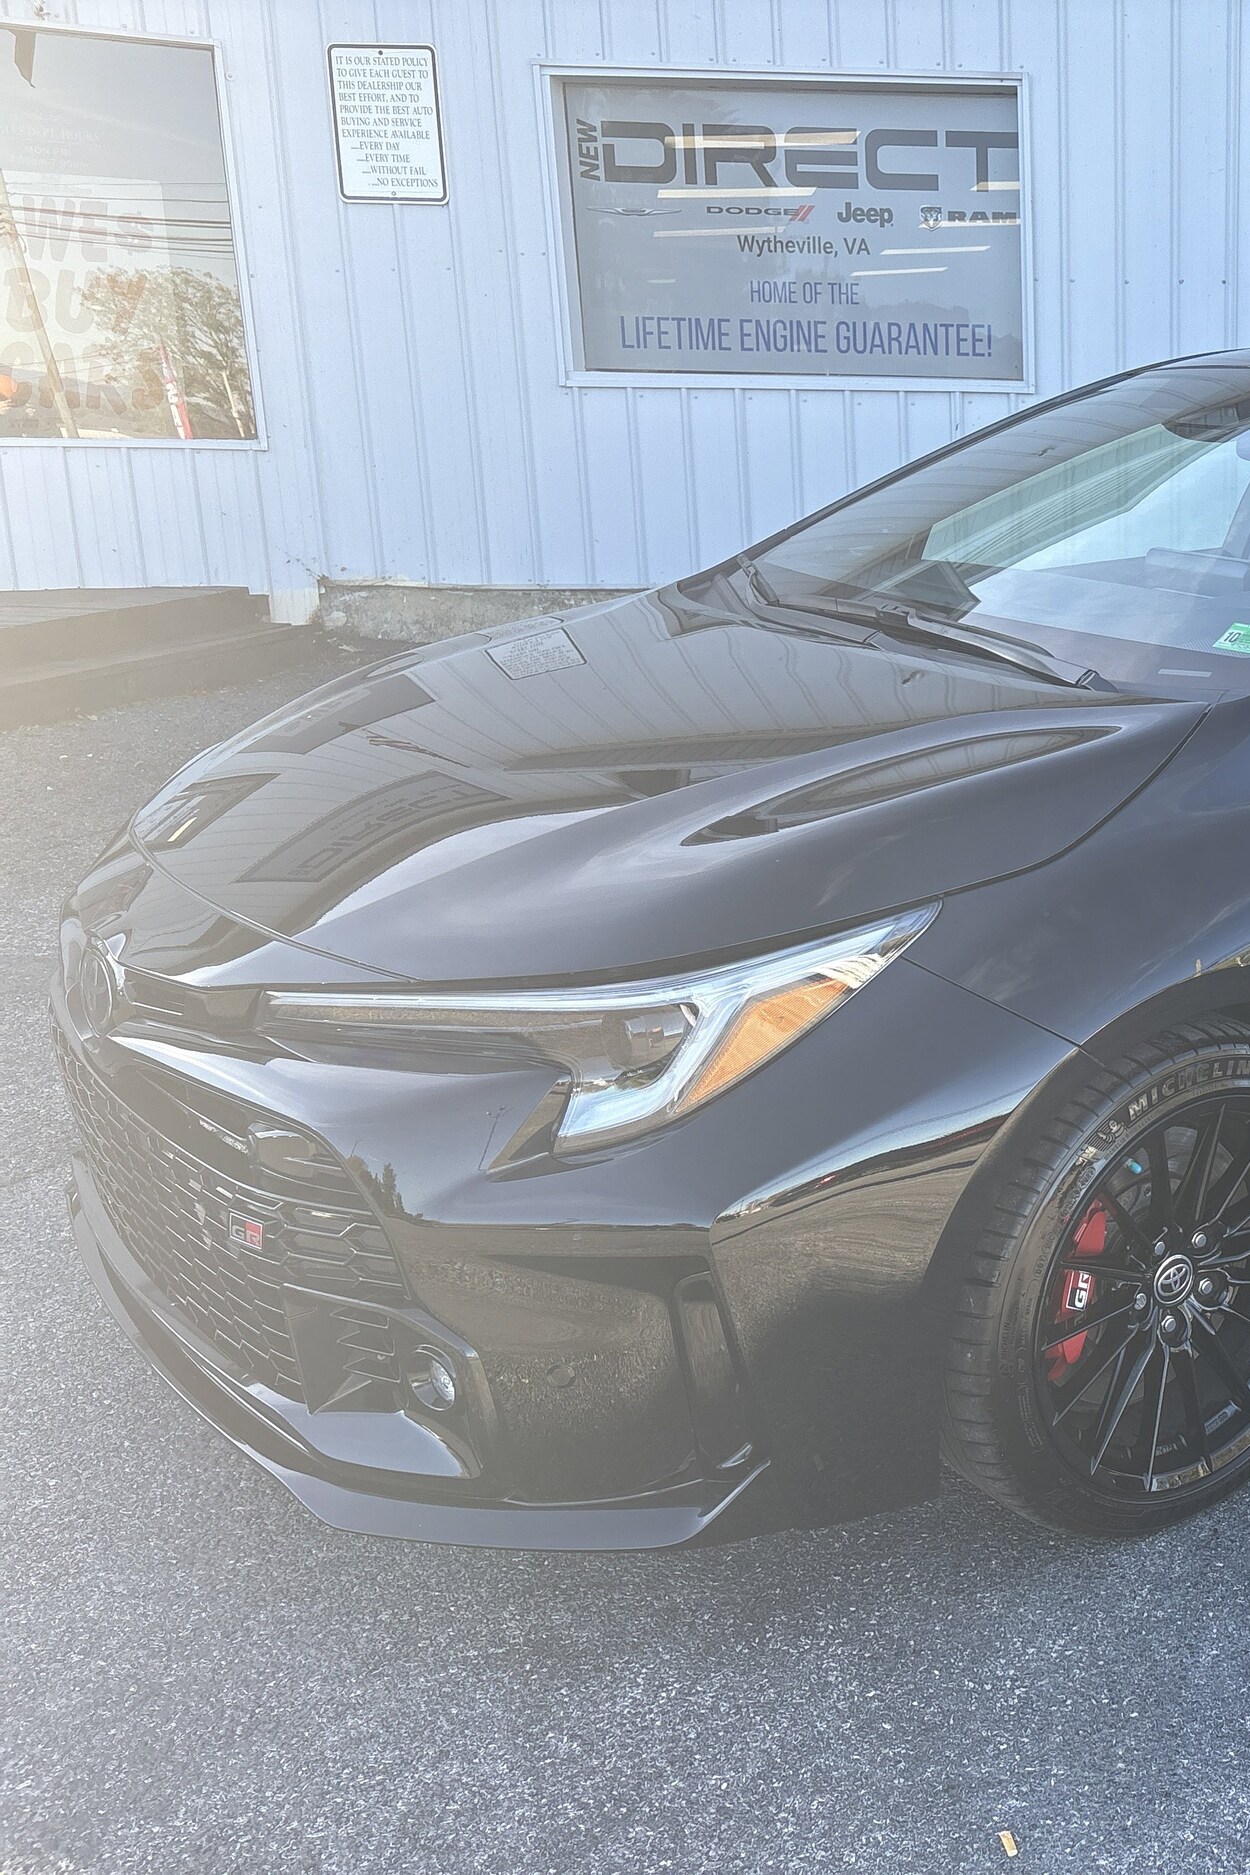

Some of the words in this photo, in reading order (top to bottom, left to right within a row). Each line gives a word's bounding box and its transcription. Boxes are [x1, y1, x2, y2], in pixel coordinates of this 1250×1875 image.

[336, 56, 342, 65] IT
[346, 56, 352, 65] IS
[354, 57, 370, 66] OUR
[373, 58, 400, 66] STATED
[402, 57, 428, 67] POLICY
[337, 68, 347, 77] TO
[349, 69, 367, 77] GIVE
[370, 69, 389, 78] EACH
[392, 70, 416, 79] GUEST
[419, 70, 428, 79] TO
[338, 81, 355, 89] THIS
[357, 81, 403, 90] DEALERSHIP
[405, 82, 422, 91] OUR
[339, 93, 356, 102] BEST
[390, 94, 407, 102] AND
[409, 94, 419, 103] TO
[340, 105, 372, 114] PROVIDE
[376, 106, 390, 114] THE
[392, 106, 409, 115] BEST
[412, 106, 433, 115] AUTO
[341, 117, 370, 126] BUYING
[372, 118, 389, 126] AND
[392, 118, 421, 127] SERVICE
[342, 129, 388, 138] EXPERIENCE
[391, 130, 430, 140] AVAILABLE
[386, 142, 400, 151] DAY
[577, 118, 601, 181] NEW
[391, 154, 410, 163] TIME
[600, 120, 1018, 191] DIRECT
[410, 167, 426, 175] FAIL
[391, 178, 438, 188] EXCEPTIONS
[706, 206, 800, 216] DODGE
[837, 202, 894, 227] Jeep
[947, 210, 1017, 223] RAM
[737, 235, 838, 257] Wytheville,
[844, 238, 871, 255] VA
[750, 280, 800, 305] HOME
[803, 282, 823, 304] OF
[827, 282, 860, 305] THE
[4, 267, 148, 335] BUY
[620, 316, 732, 352] LIFETIME
[740, 319, 828, 354] ENGINE
[835, 321, 993, 358] GUARANTEE!
[1223, 631, 1241, 643] 10
[231, 1225, 261, 1247] GR
